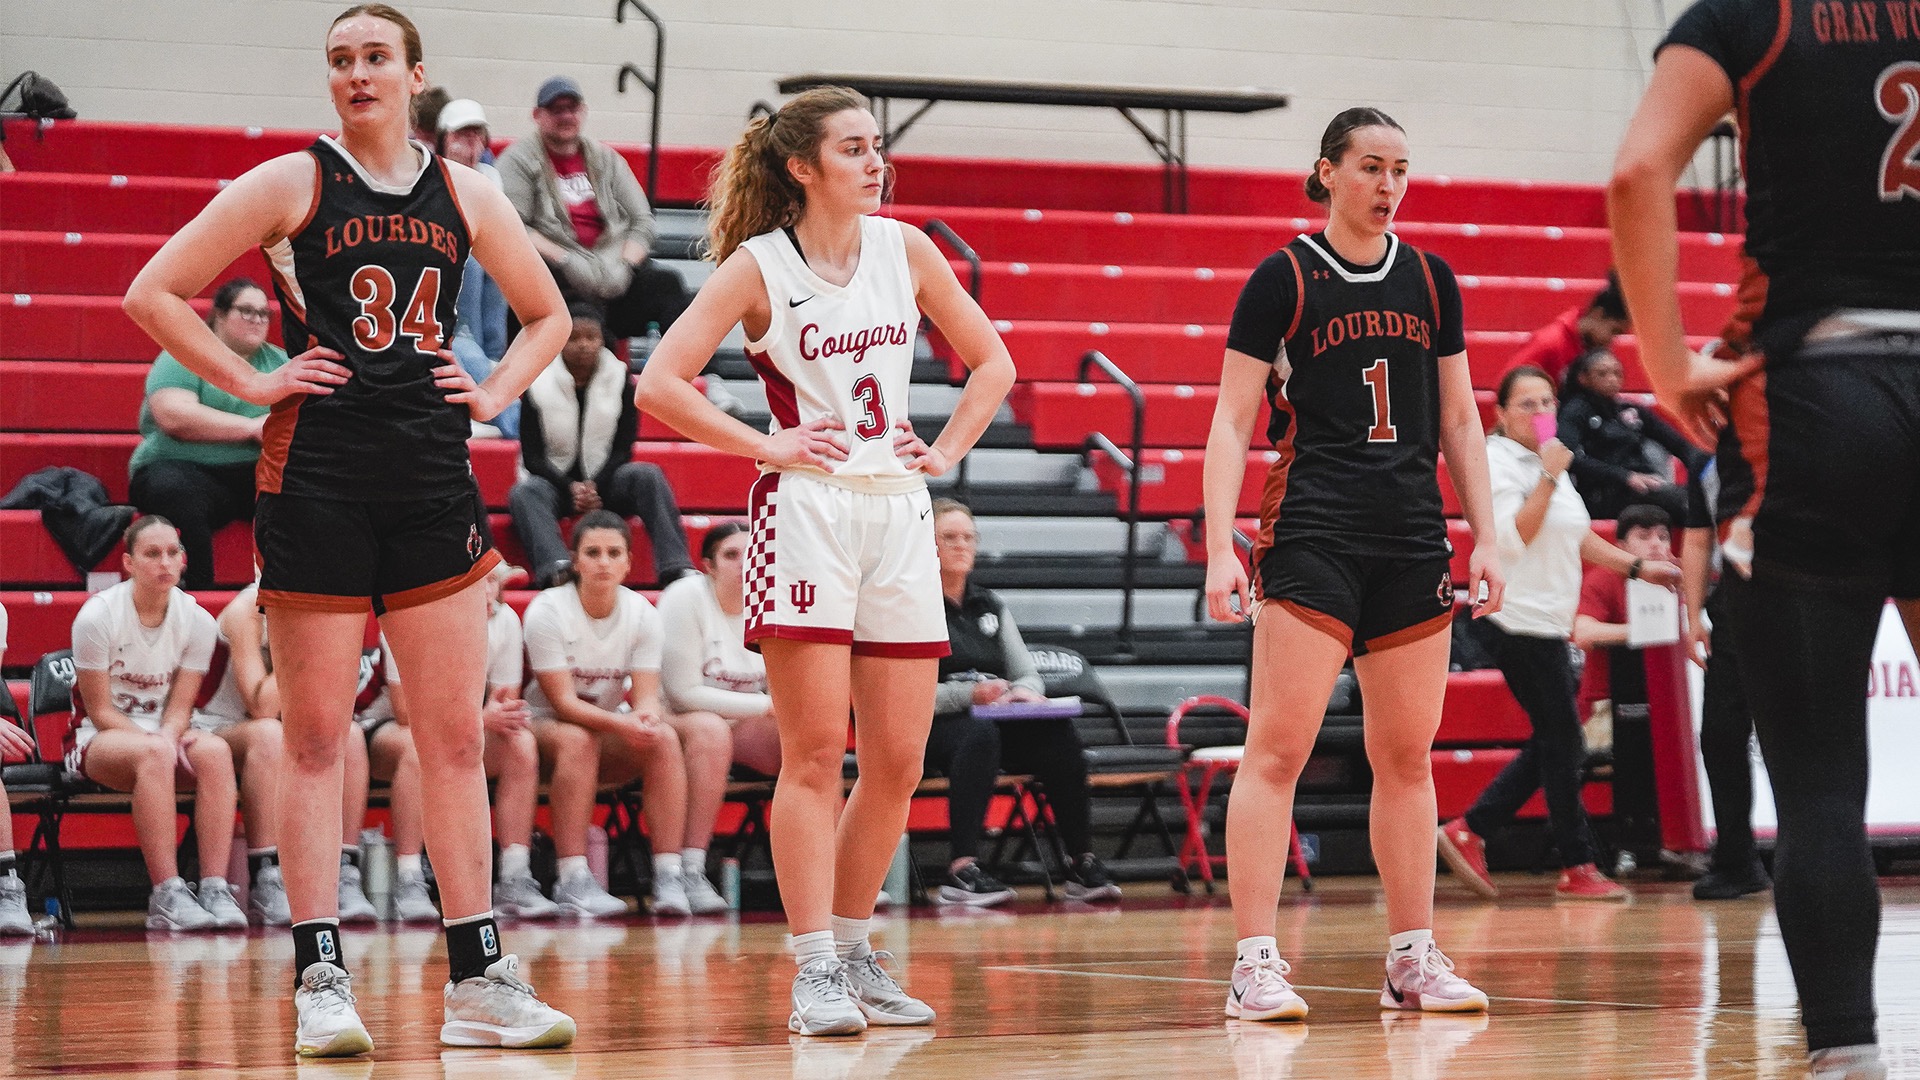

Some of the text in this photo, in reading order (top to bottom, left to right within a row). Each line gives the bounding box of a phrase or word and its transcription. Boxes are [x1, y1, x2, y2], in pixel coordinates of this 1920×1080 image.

[1812, 0, 1879, 43] GRAY
[325, 214, 458, 264] LOURDES
[350, 264, 444, 355] 34
[1311, 310, 1431, 357] LOURDES
[799, 322, 907, 363] Cougars
[851, 373, 889, 442] 3
[1362, 358, 1397, 442] 1
